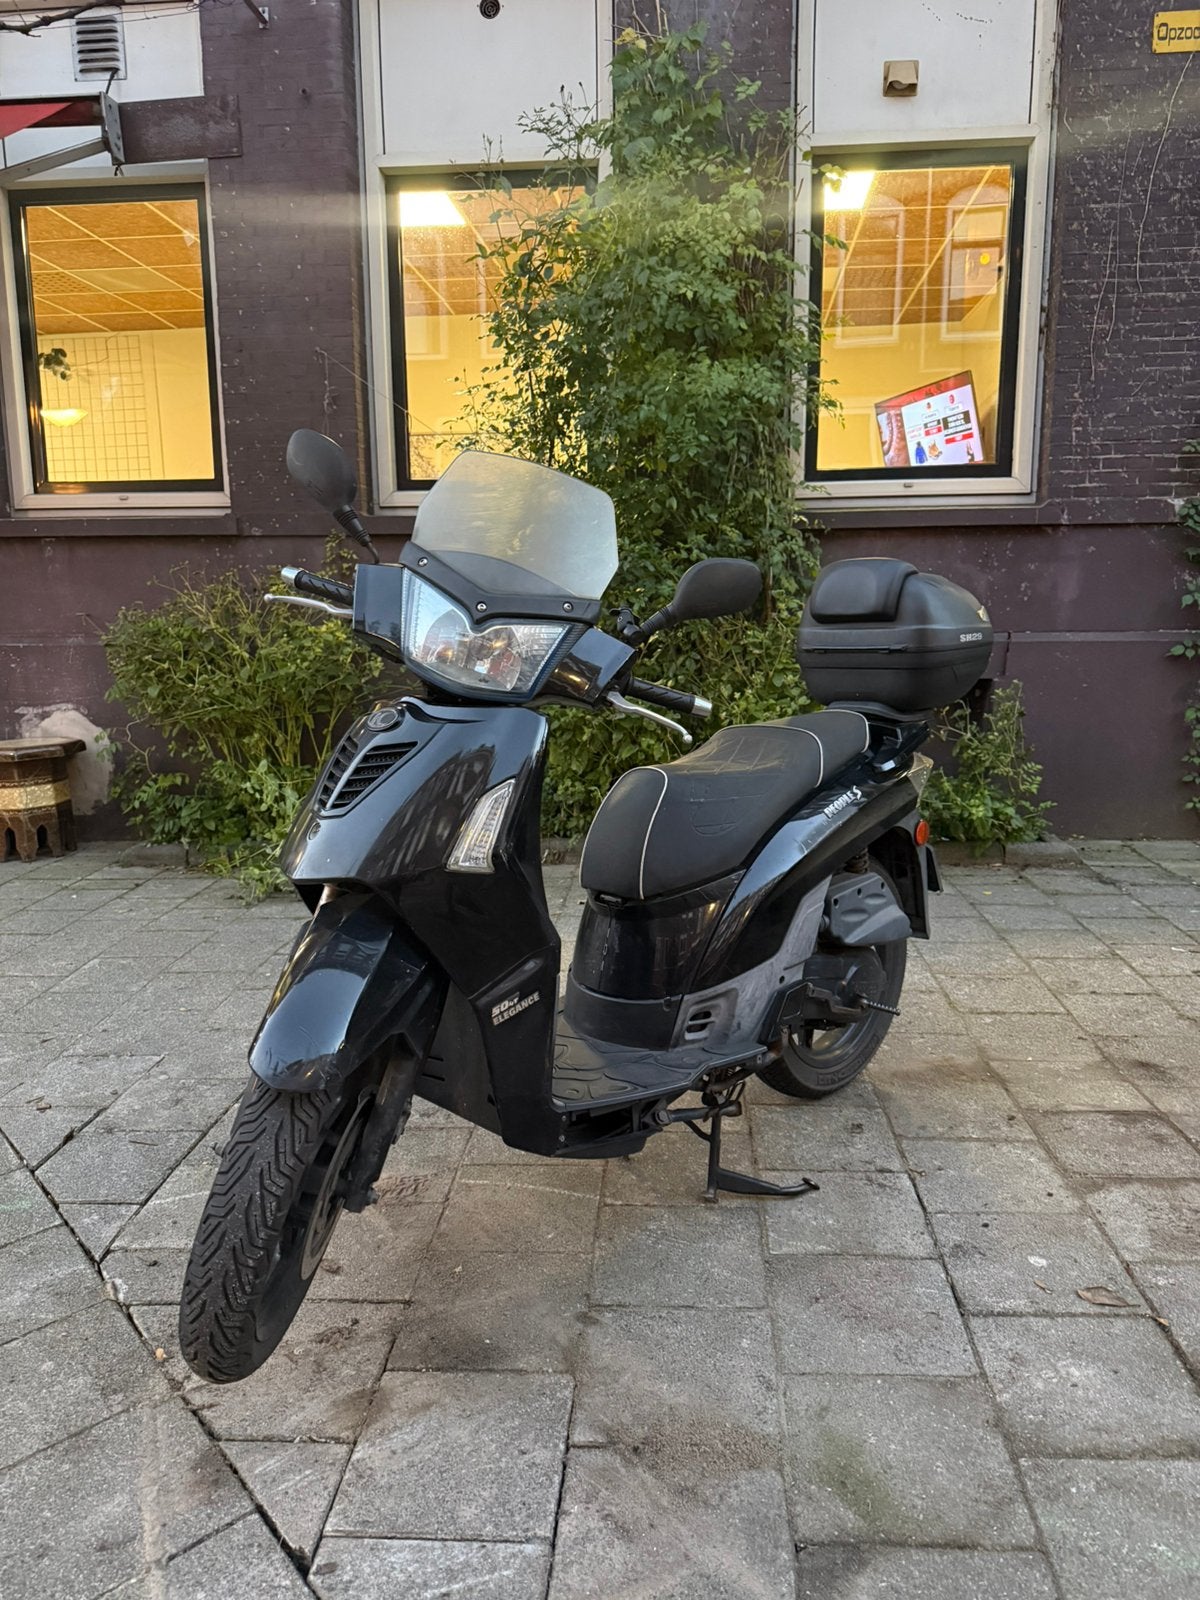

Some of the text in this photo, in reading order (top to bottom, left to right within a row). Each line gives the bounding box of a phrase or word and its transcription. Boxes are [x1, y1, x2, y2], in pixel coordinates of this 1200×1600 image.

[823, 785, 862, 818] PEOPLE S
[492, 991, 540, 1026] ELEGANCE
